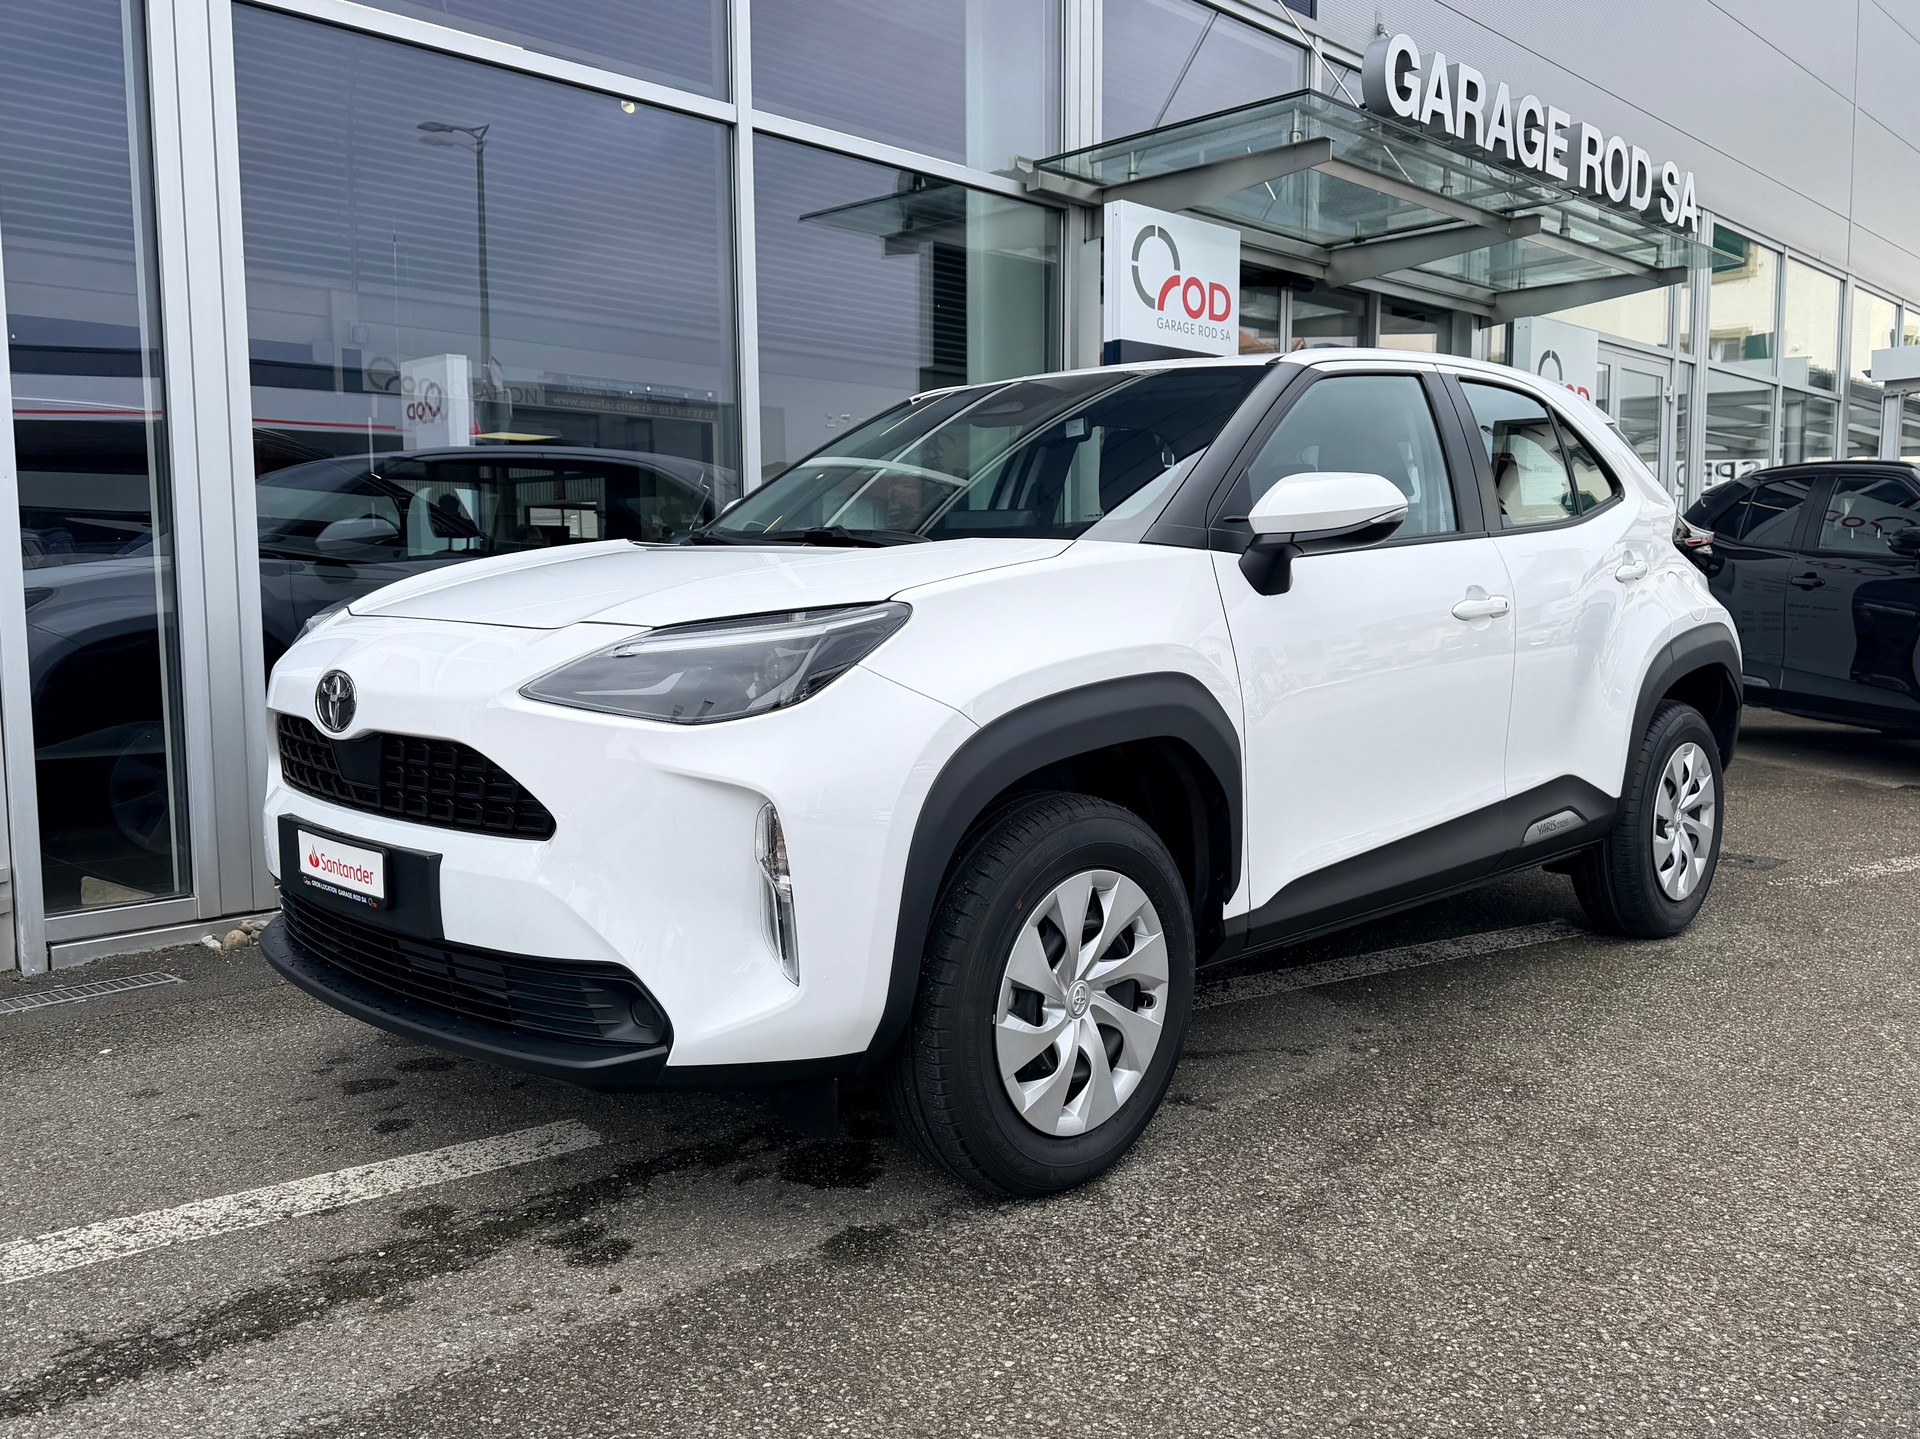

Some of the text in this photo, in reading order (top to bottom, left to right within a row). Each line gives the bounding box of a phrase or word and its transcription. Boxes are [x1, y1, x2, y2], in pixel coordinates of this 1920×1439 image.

[1384, 33, 1699, 233] GARAGE ROD SA
[1156, 317, 1231, 341] GARAGE ROD SA
[320, 852, 374, 885] Santander
[338, 889, 353, 899] GARAGE
[353, 893, 361, 902] ROD
